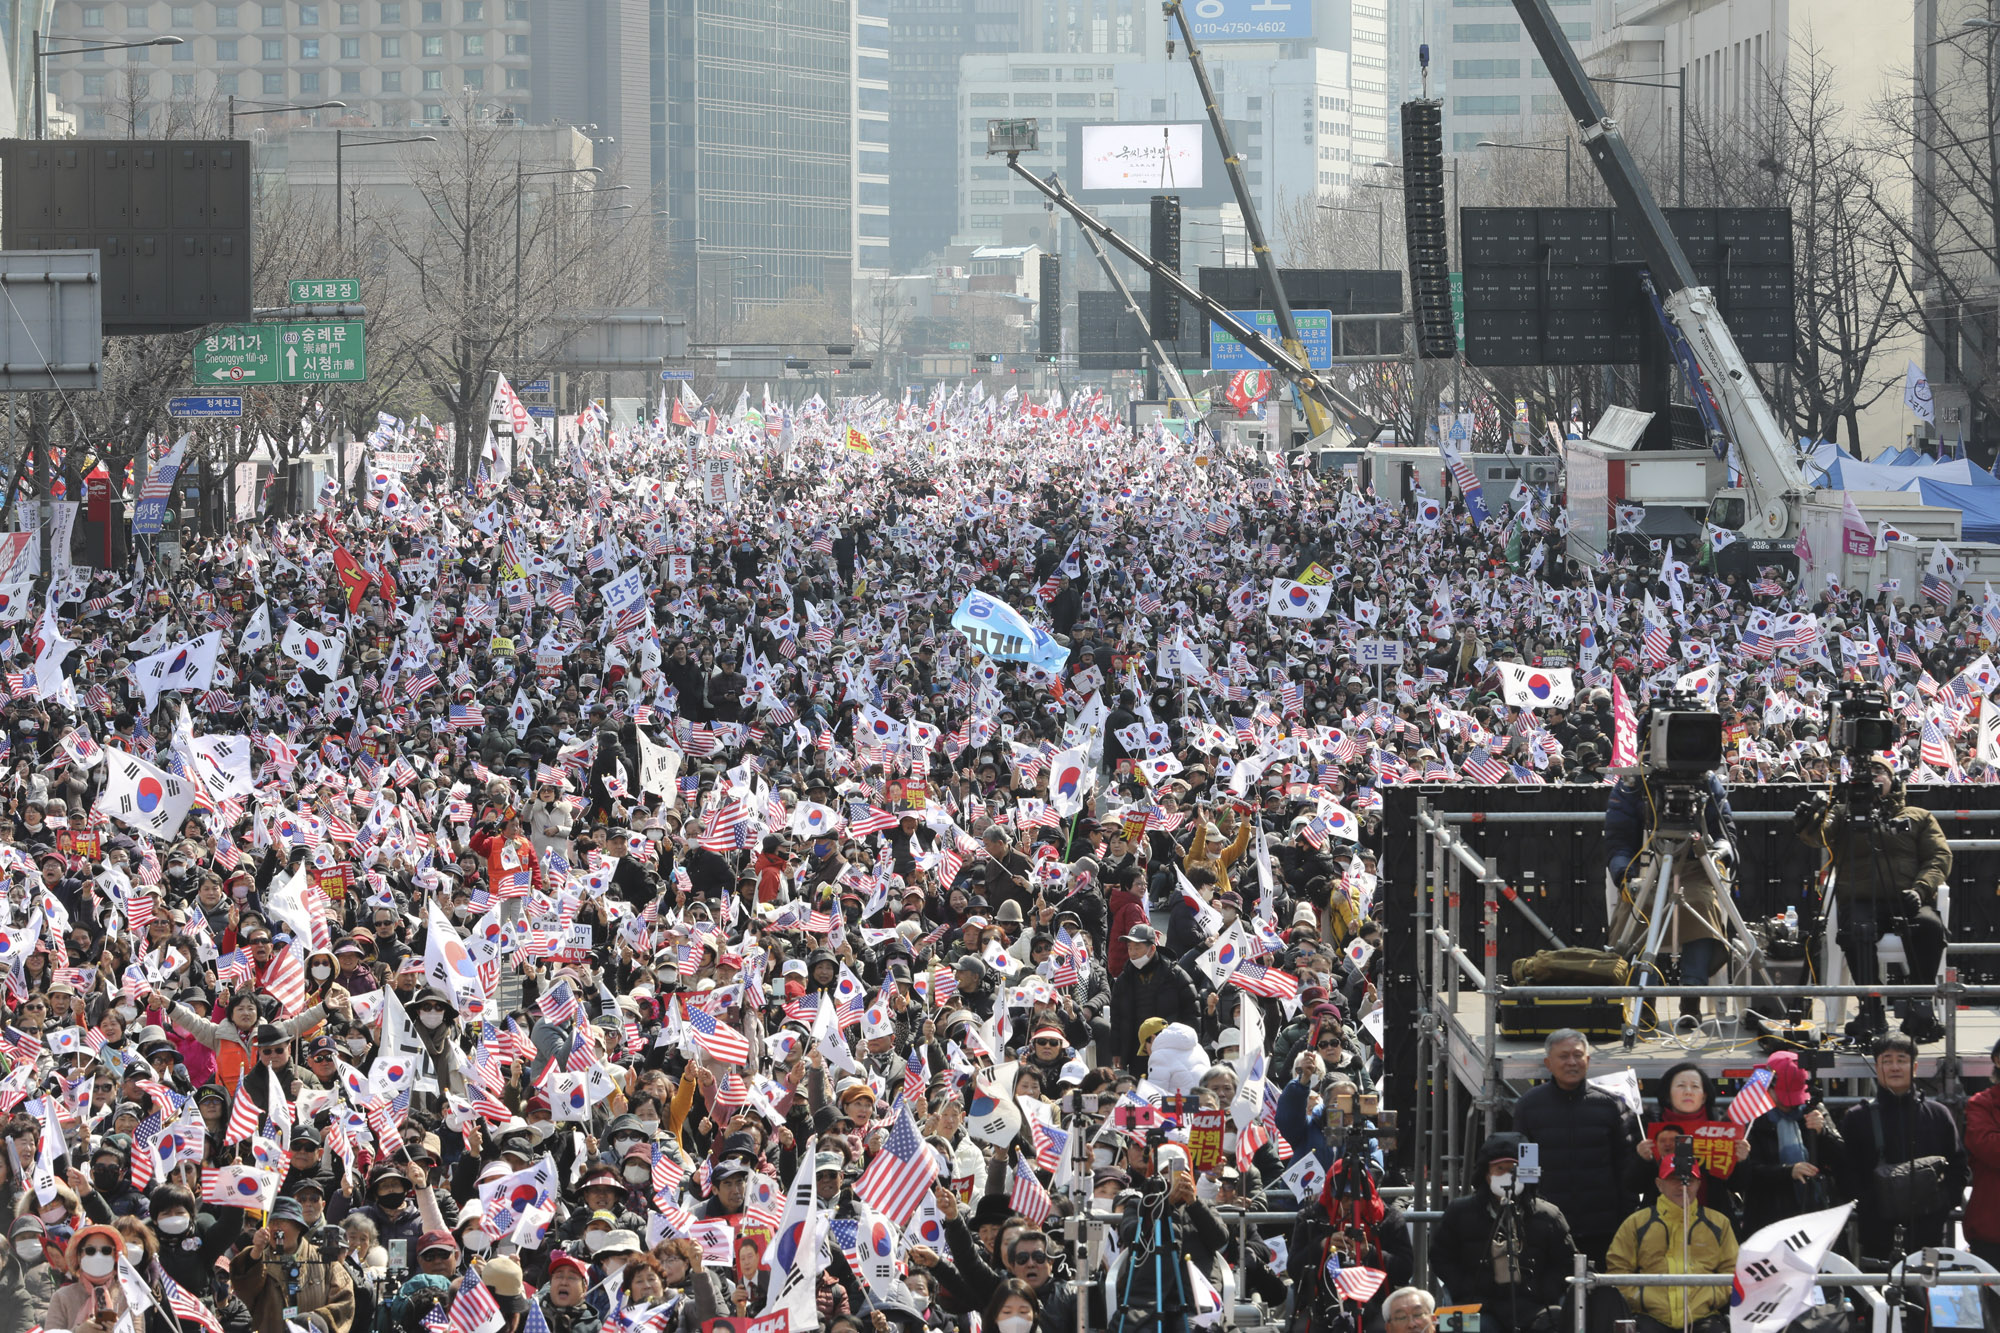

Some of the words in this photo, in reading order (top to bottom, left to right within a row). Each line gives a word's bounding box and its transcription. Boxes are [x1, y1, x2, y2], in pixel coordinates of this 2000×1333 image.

[1194, 22, 1286, 34] 010-4750-4602
[297, 283, 352, 299] 청계광장
[285, 333, 297, 343] 60
[301, 326, 347, 343] 숭례문
[204, 335, 262, 352] 청계1가
[1217, 344, 1242, 352] 소공로
[204, 353, 244, 366] Cheonggye
[303, 356, 332, 371] 시청
[303, 371, 320, 381] City
[324, 371, 340, 379] Hall
[491, 399, 506, 415] THE
[961, 625, 1024, 656] 거제
[1362, 644, 1398, 660] 전북
[906, 789, 925, 800] 탄핵
[906, 798, 926, 809] 기각
[320, 868, 343, 878] 4대4
[320, 876, 344, 890] 탄핵
[574, 926, 591, 934] OUT
[1192, 1115, 1222, 1128] 4대4
[1694, 1126, 1736, 1137] 4대4
[1187, 1130, 1220, 1149] 탄핵
[1693, 1138, 1734, 1157] 탄핵
[1189, 1148, 1219, 1167] 기각
